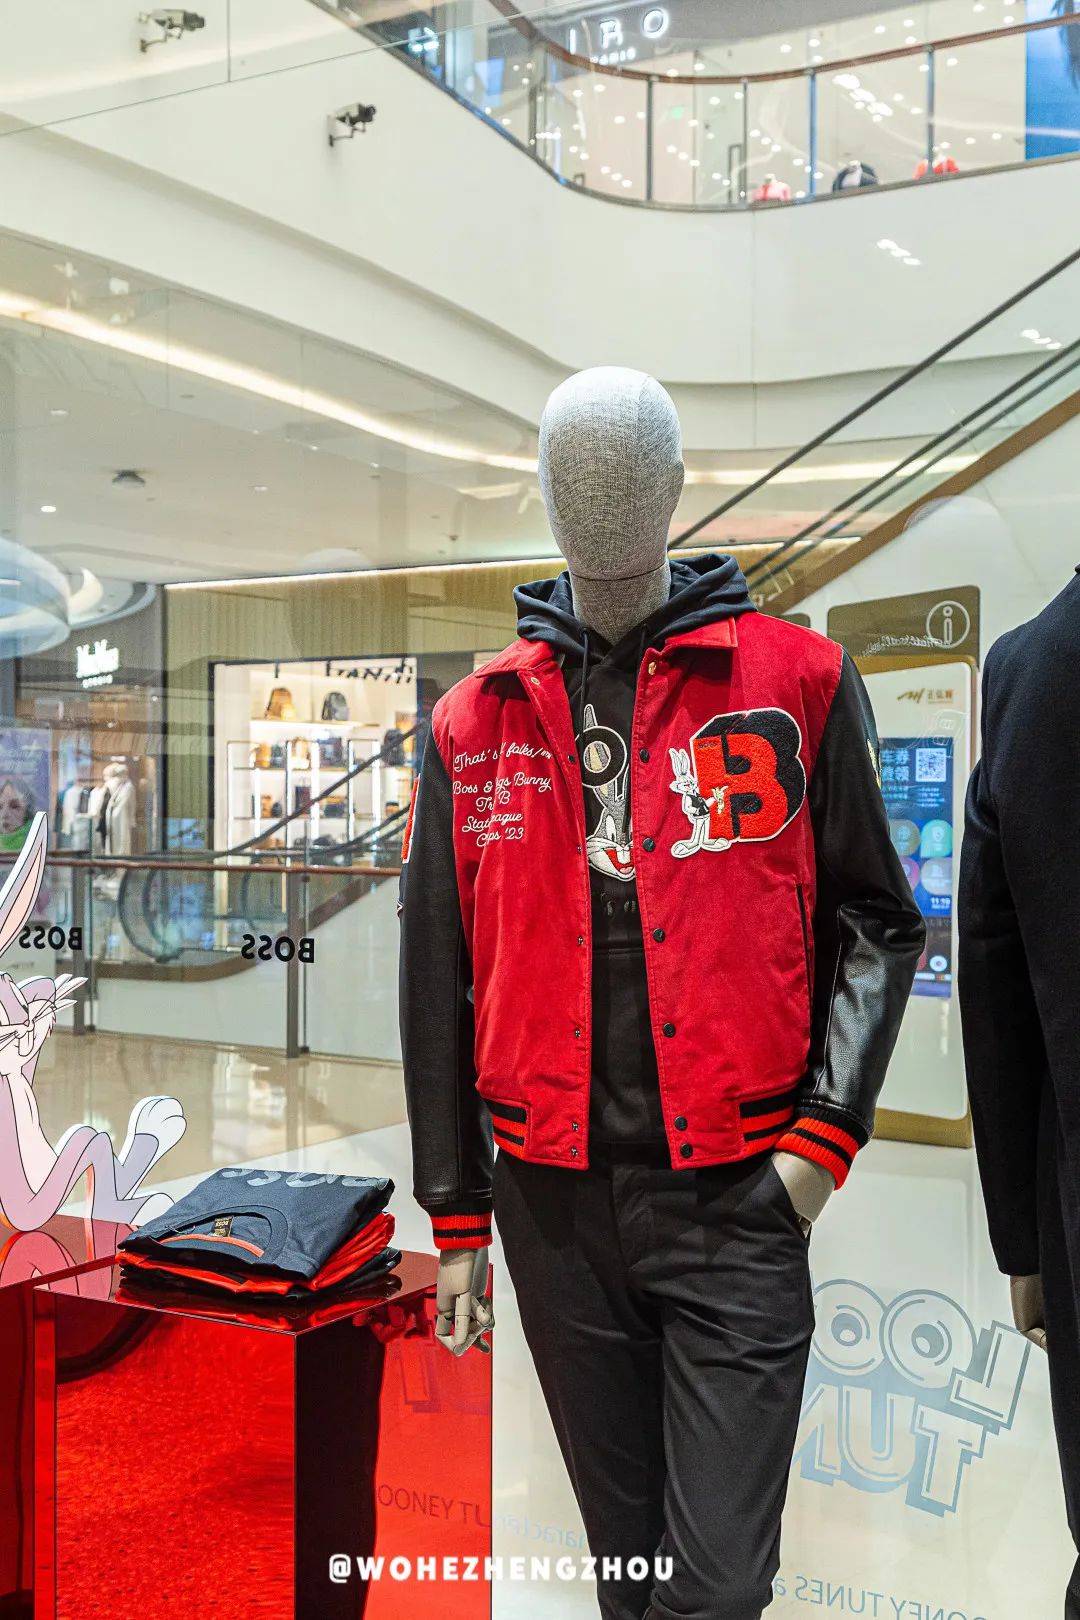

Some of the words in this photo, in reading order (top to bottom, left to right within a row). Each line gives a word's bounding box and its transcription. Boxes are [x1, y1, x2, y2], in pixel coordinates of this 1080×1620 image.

[568, 7, 670, 55] IRO
[453, 748, 498, 772] That's
[453, 781, 478, 795] Boss
[483, 781, 493, 793] &
[513, 772, 552, 793] Bunny
[504, 827, 524, 840] '23
